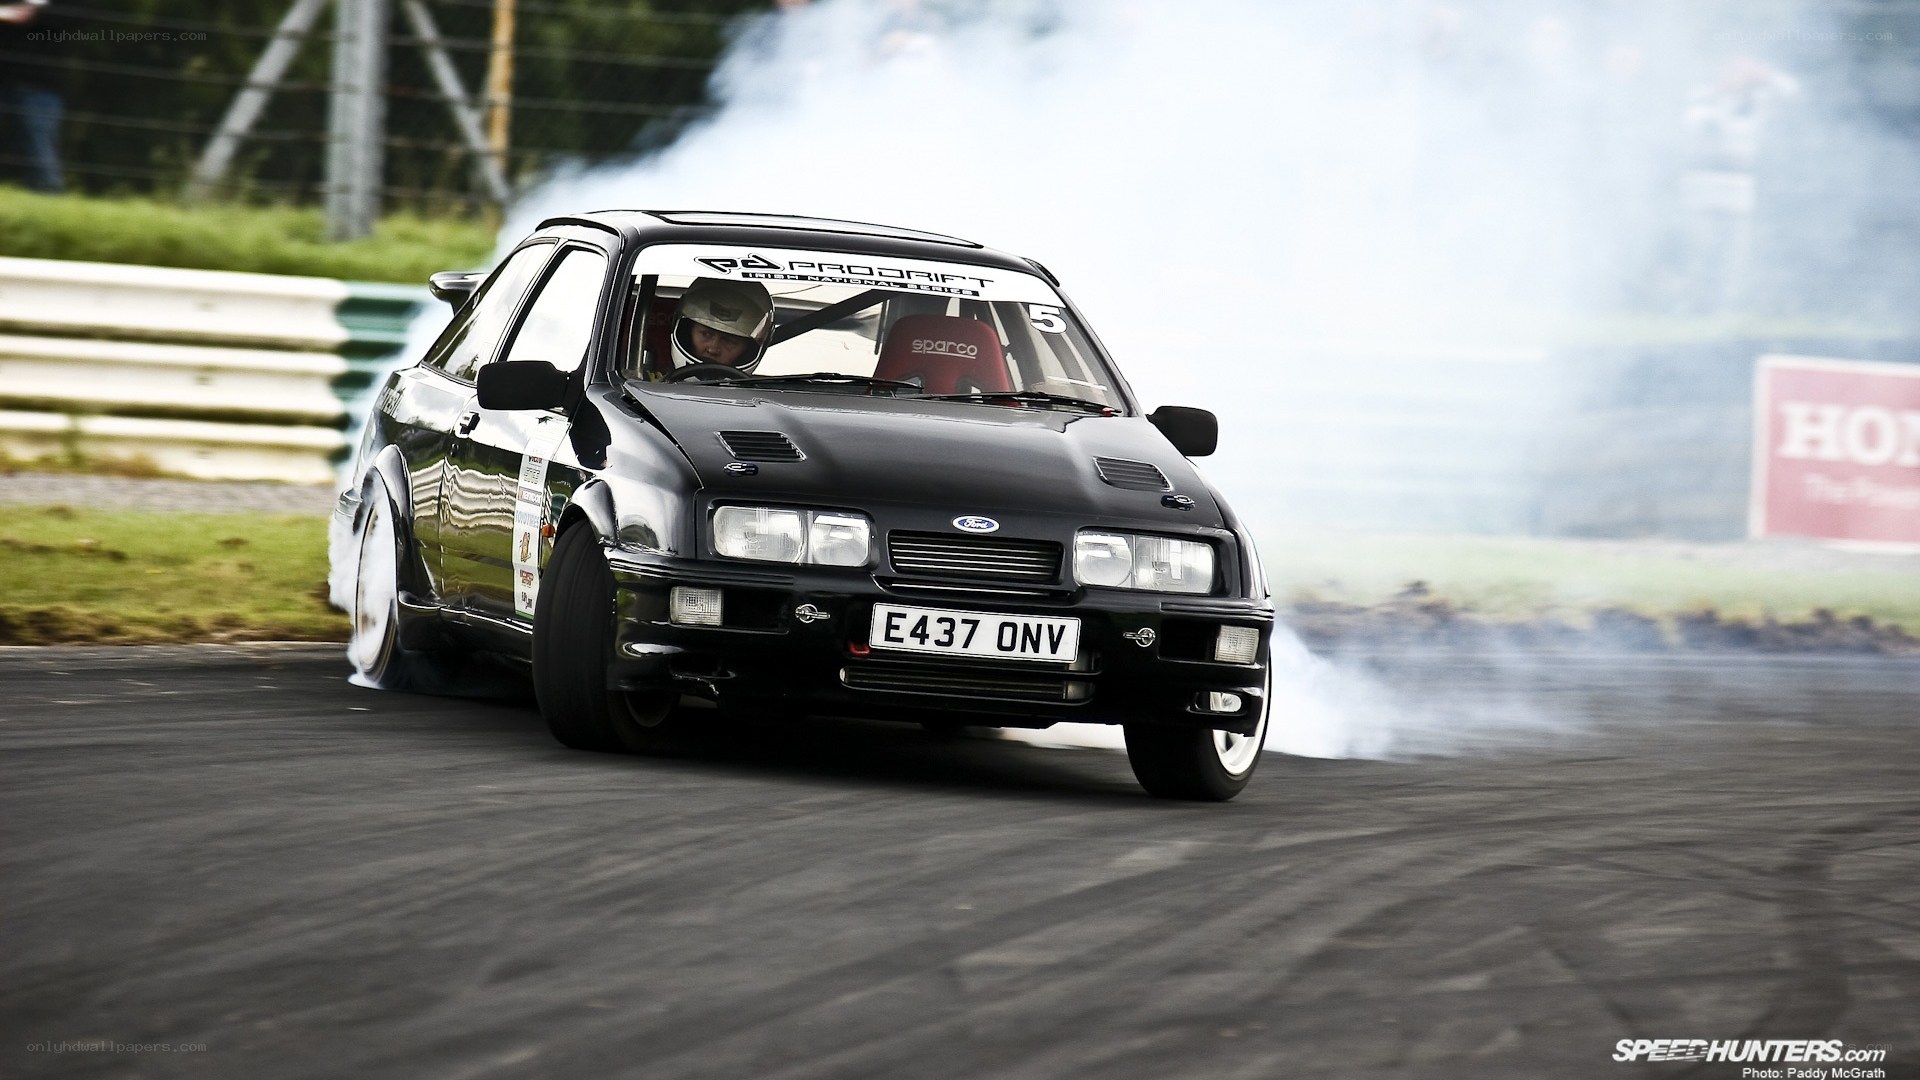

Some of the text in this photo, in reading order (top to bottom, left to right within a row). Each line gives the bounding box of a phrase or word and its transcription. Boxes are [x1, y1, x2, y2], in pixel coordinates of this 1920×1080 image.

[747, 273, 974, 296] IRISH NATIONAL SERIES
[788, 260, 995, 288] PRODRIFT
[1029, 304, 1067, 334] 5
[912, 338, 978, 356] sparco
[884, 611, 1066, 654] E437 ONV
